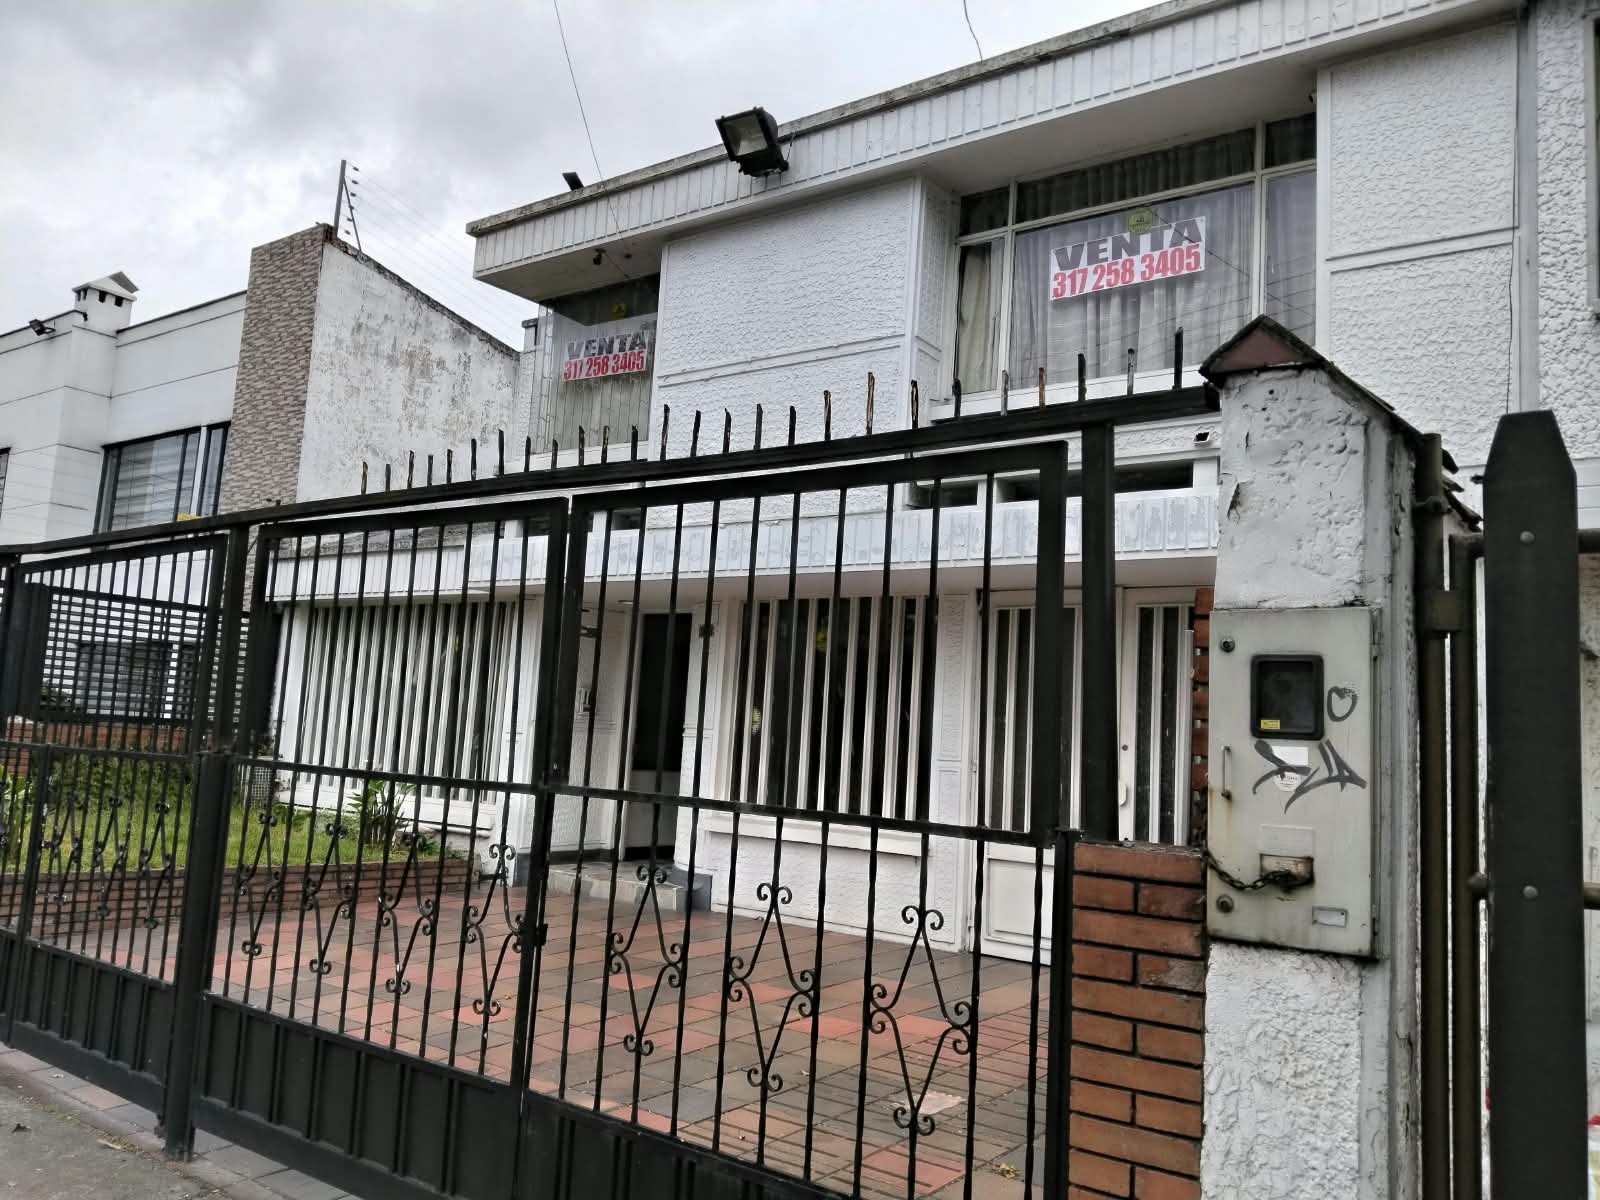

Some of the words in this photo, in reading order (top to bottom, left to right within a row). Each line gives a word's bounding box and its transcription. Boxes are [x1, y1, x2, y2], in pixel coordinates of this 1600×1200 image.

[1053, 219, 1202, 271] VENTA
[1052, 267, 1088, 299] 317
[1092, 256, 1135, 291] 258
[1140, 244, 1201, 282] 3405
[563, 360, 584, 380] 317
[585, 355, 610, 377] 258
[611, 350, 645, 374] 3405
[566, 330, 647, 359] VENTA
